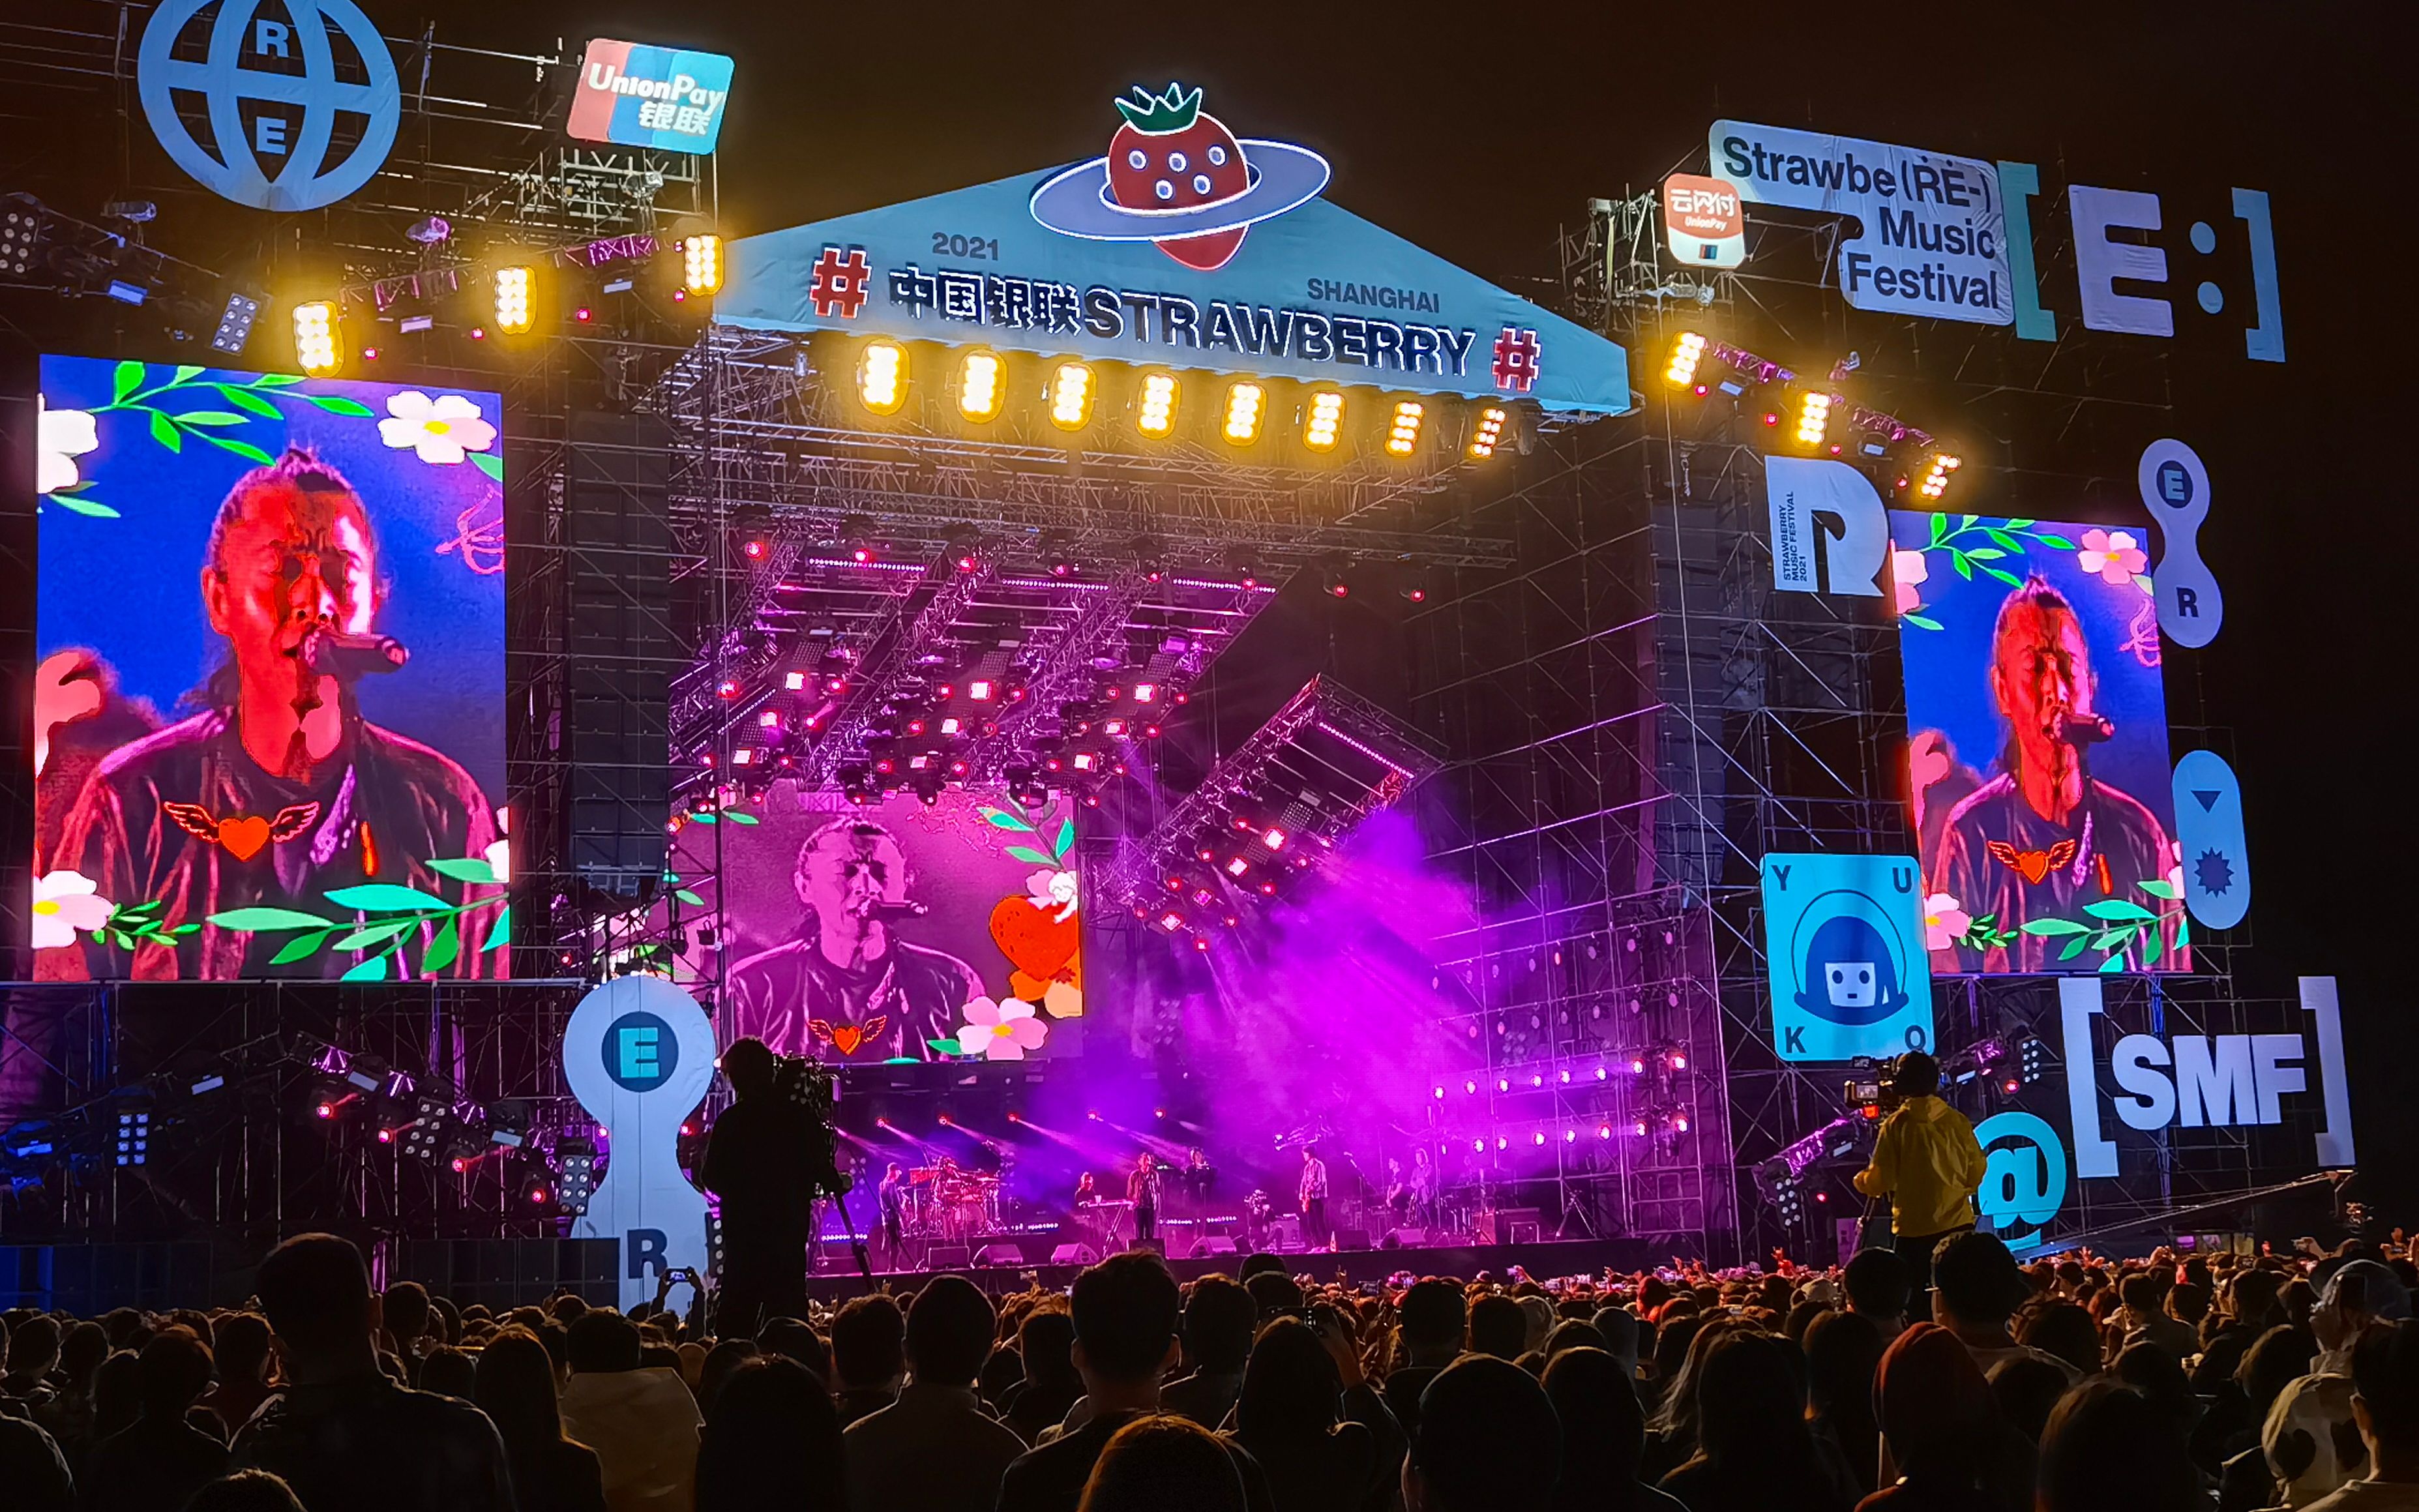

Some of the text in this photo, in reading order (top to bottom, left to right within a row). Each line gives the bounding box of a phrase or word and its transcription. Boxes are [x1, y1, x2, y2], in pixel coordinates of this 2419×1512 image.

[589, 63, 724, 115] UnionPay
[639, 101, 711, 136] 银联
[1685, 216, 1727, 231] UnionPay
[1879, 207, 1995, 260] Music
[932, 232, 999, 261] 2021
[1307, 278, 1439, 313] SHANGHAI
[1847, 252, 1999, 309] Festival
[2163, 469, 2185, 501] E
[1779, 505, 1791, 580] STRAWBERRY
[1786, 492, 1799, 581] MUSIC FESTIVAL
[1799, 556, 1807, 582] 2021
[2176, 586, 2199, 618] R
[1772, 865, 1912, 893] Y U
[619, 1027, 659, 1078] E
[1785, 1026, 1807, 1054] K
[627, 1228, 668, 1279] R
